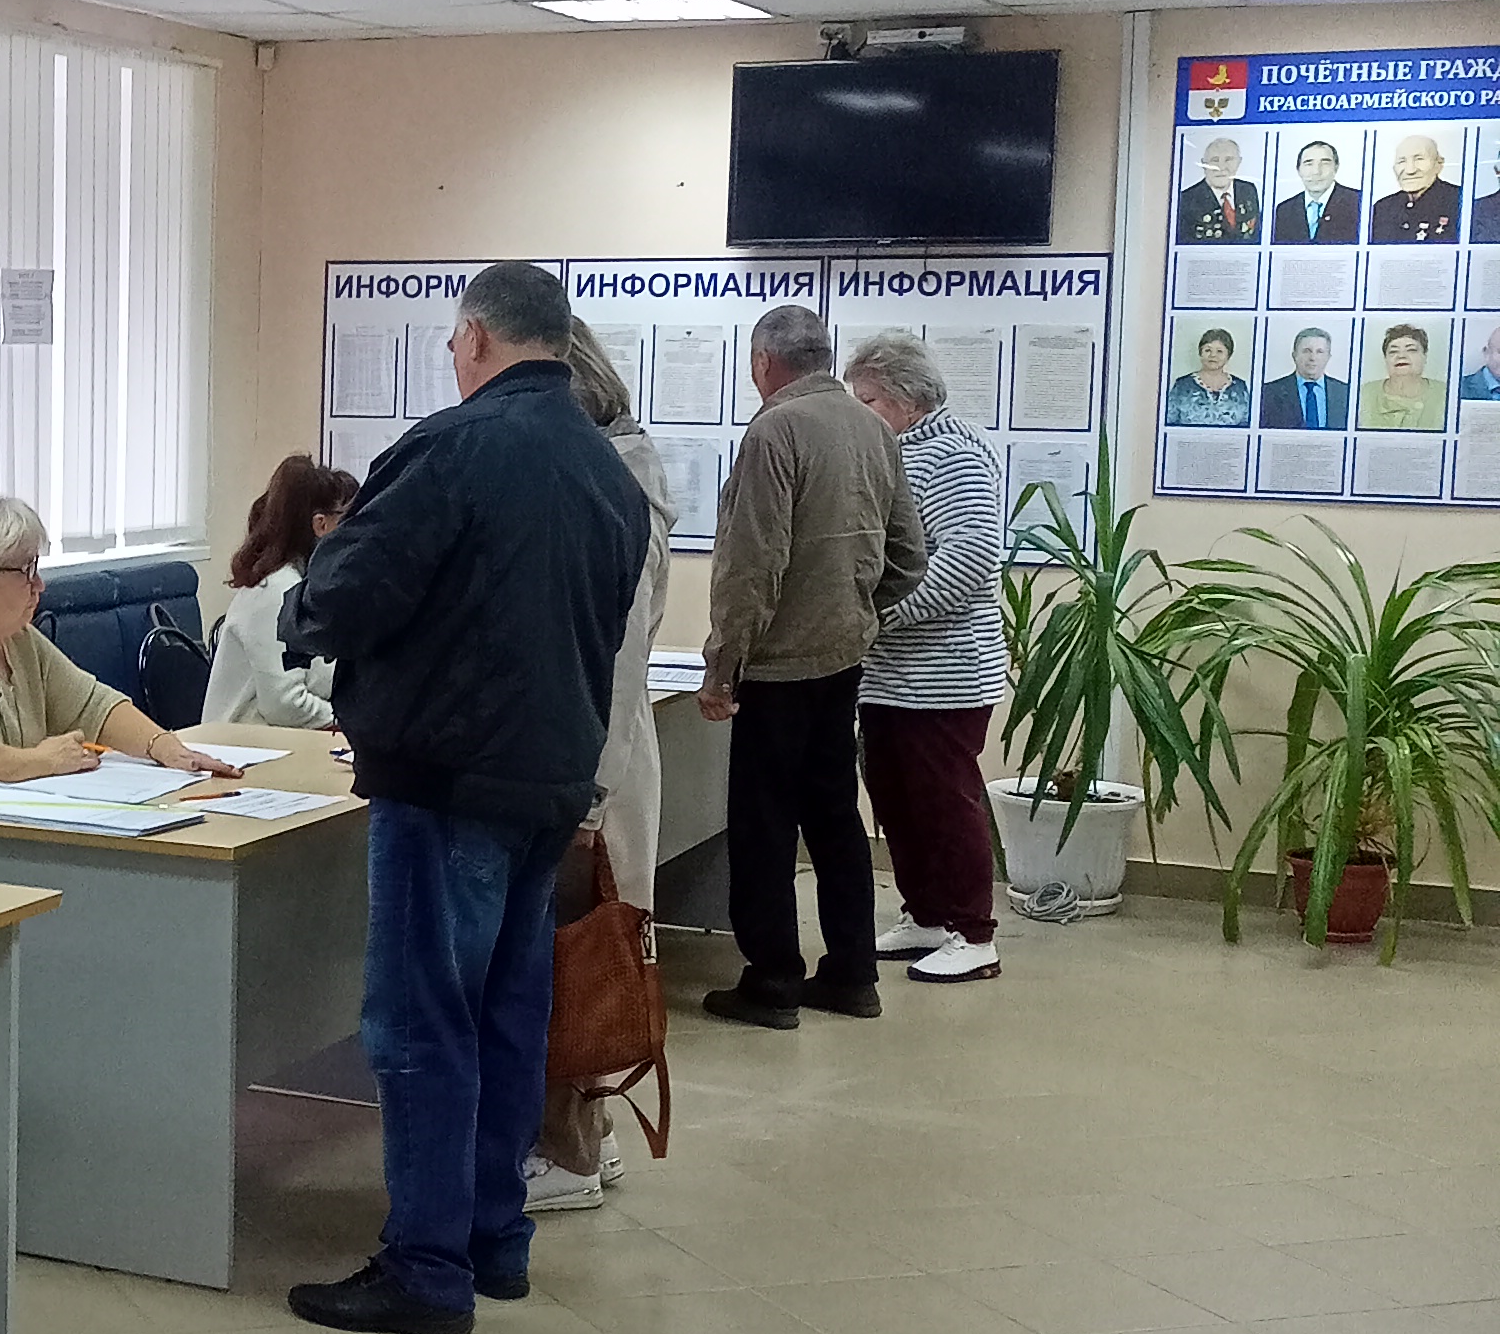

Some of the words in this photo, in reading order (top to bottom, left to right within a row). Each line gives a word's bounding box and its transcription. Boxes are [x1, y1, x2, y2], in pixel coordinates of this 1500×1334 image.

[1261, 59, 1412, 85] ПОЧЁТНЫЕ
[1258, 88, 1475, 111] КРАСНОАРМЕЙСКОГО
[334, 274, 467, 299] ИНФОРМ
[575, 272, 814, 302] ИНФОРМАЦИЯ
[838, 269, 1100, 301] ИНФОРМАЦИЯ
